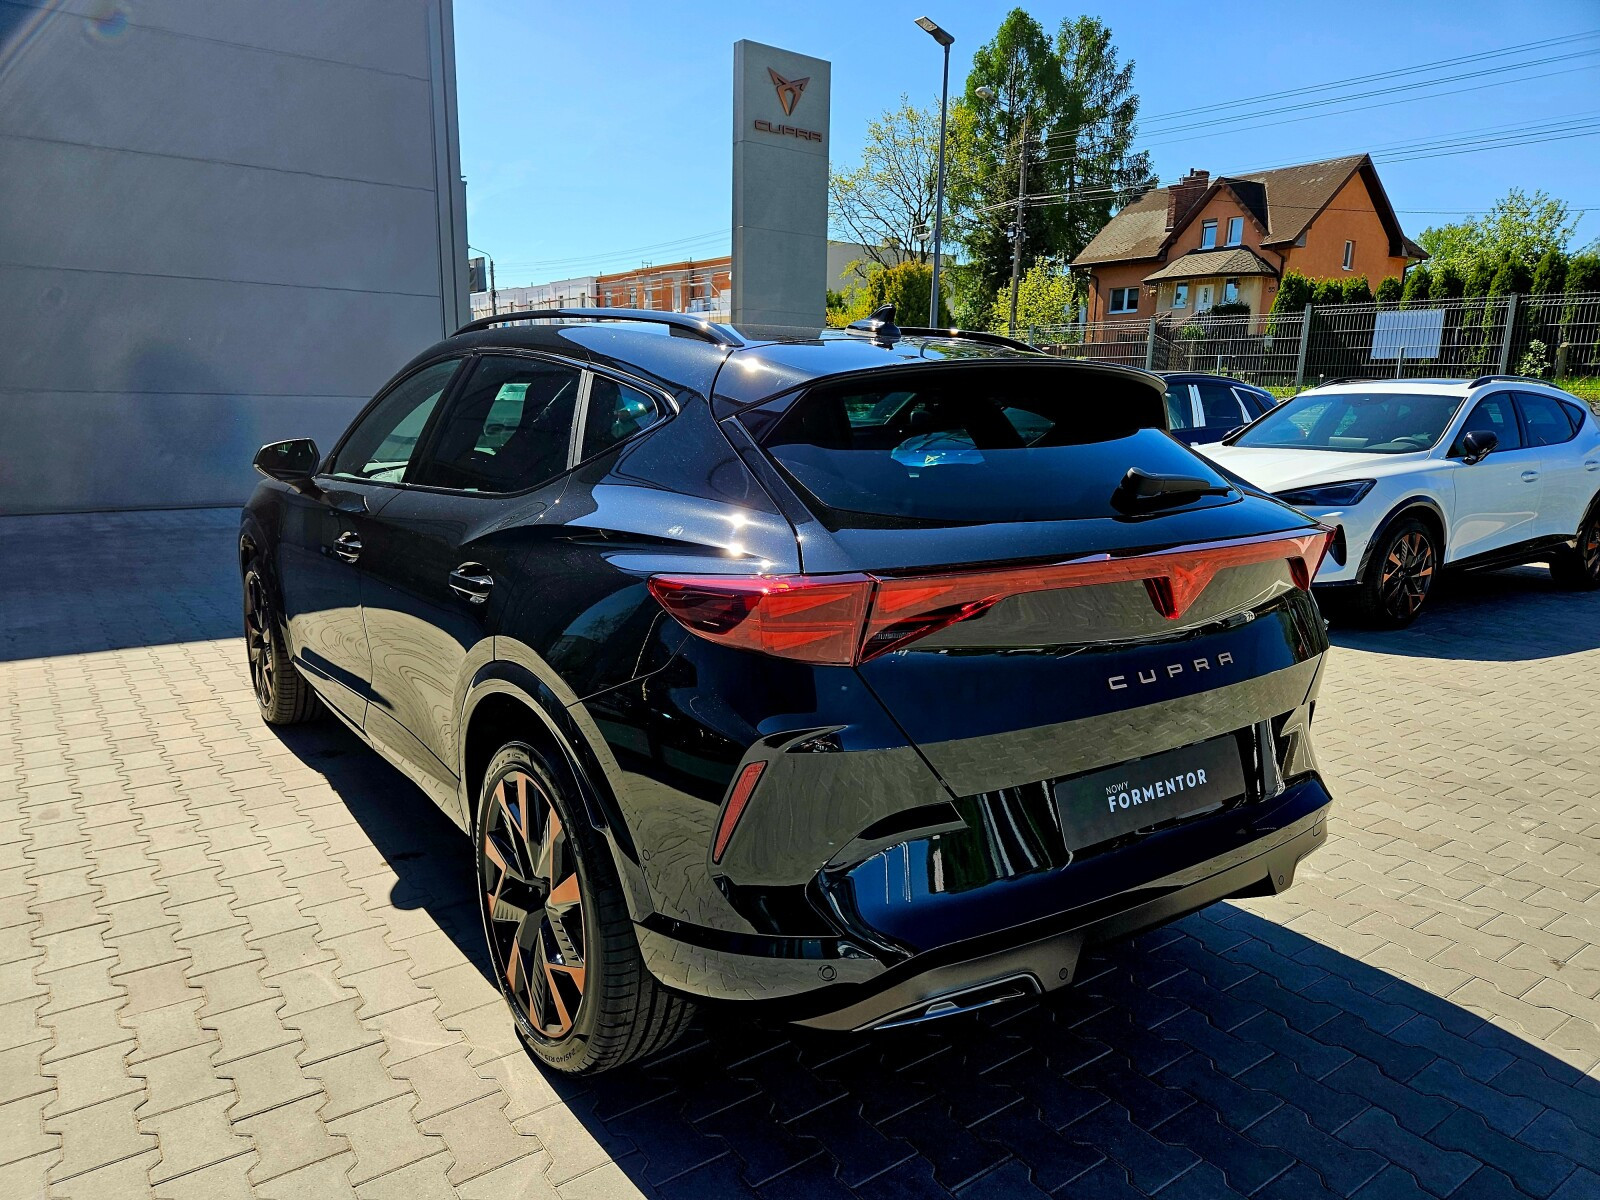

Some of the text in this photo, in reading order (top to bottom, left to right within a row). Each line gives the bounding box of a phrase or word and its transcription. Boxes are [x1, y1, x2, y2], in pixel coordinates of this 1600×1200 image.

[754, 119, 823, 143] CUPRA
[1108, 652, 1234, 690] CUPRA
[1105, 781, 1129, 795] NOWY
[1107, 768, 1208, 813] FORMENTOR
